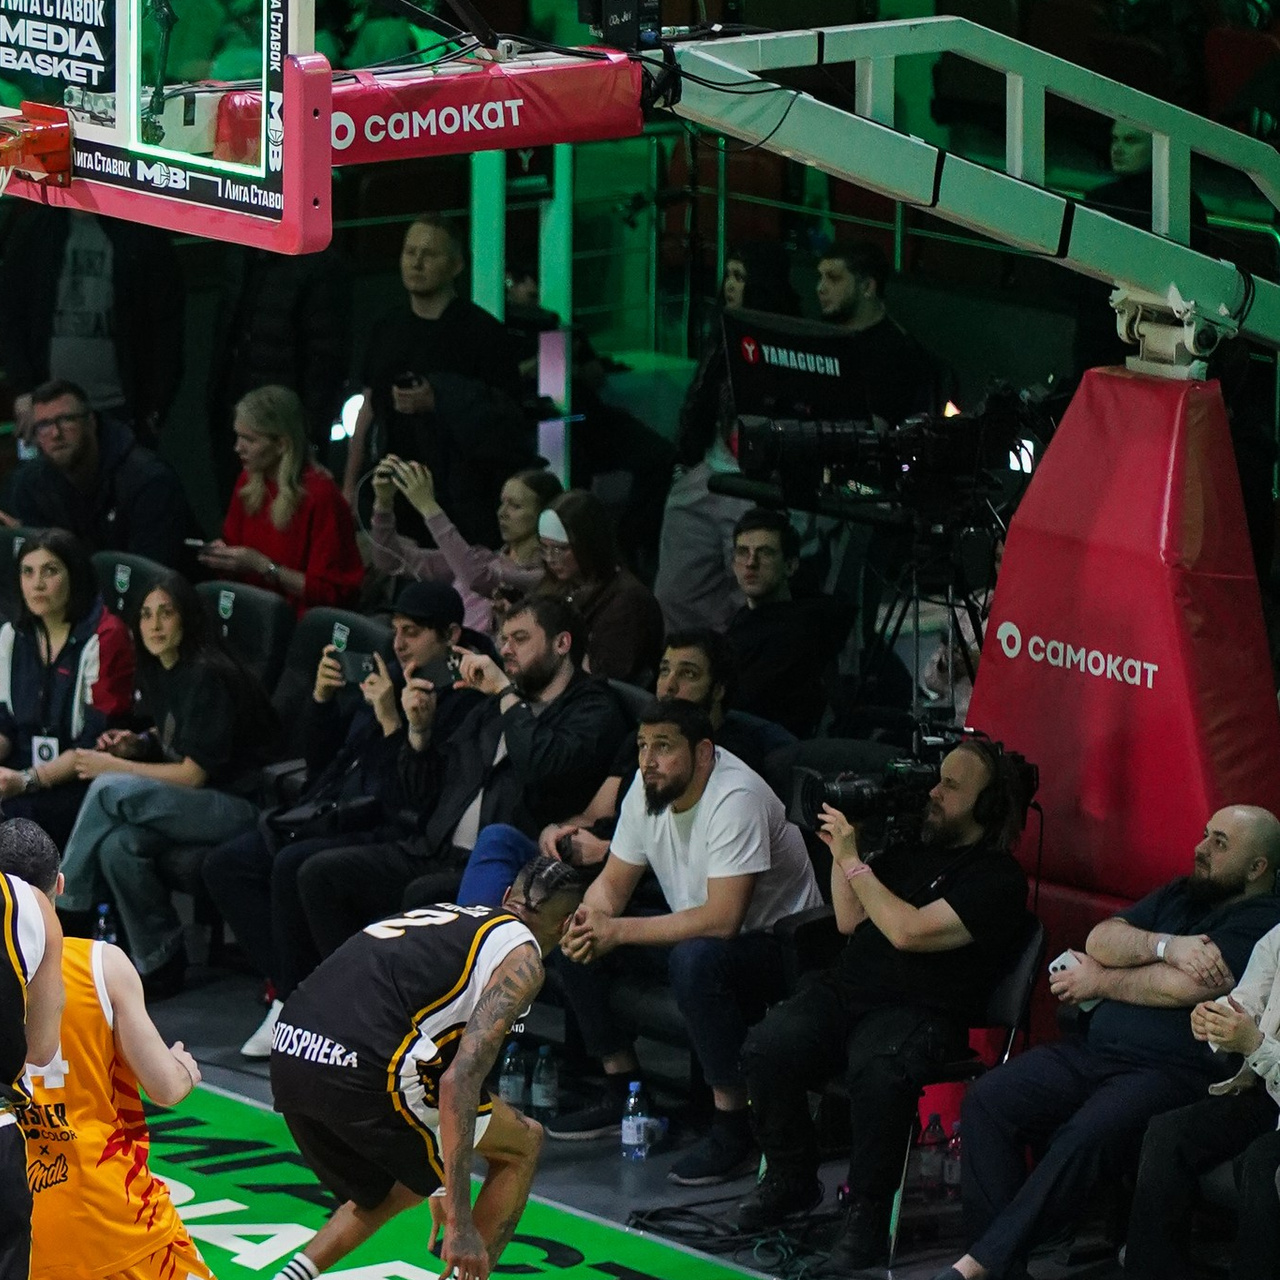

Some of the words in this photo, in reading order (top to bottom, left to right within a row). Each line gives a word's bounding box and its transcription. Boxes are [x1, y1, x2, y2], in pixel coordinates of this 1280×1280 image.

[0, 14, 104, 61] MEDIA
[0, 46, 105, 86] BASKET
[761, 343, 841, 377] YAMAGUCHI
[362, 907, 460, 939] 2
[16, 1102, 69, 1129] ASTER
[41, 1129, 78, 1142] COLOR
